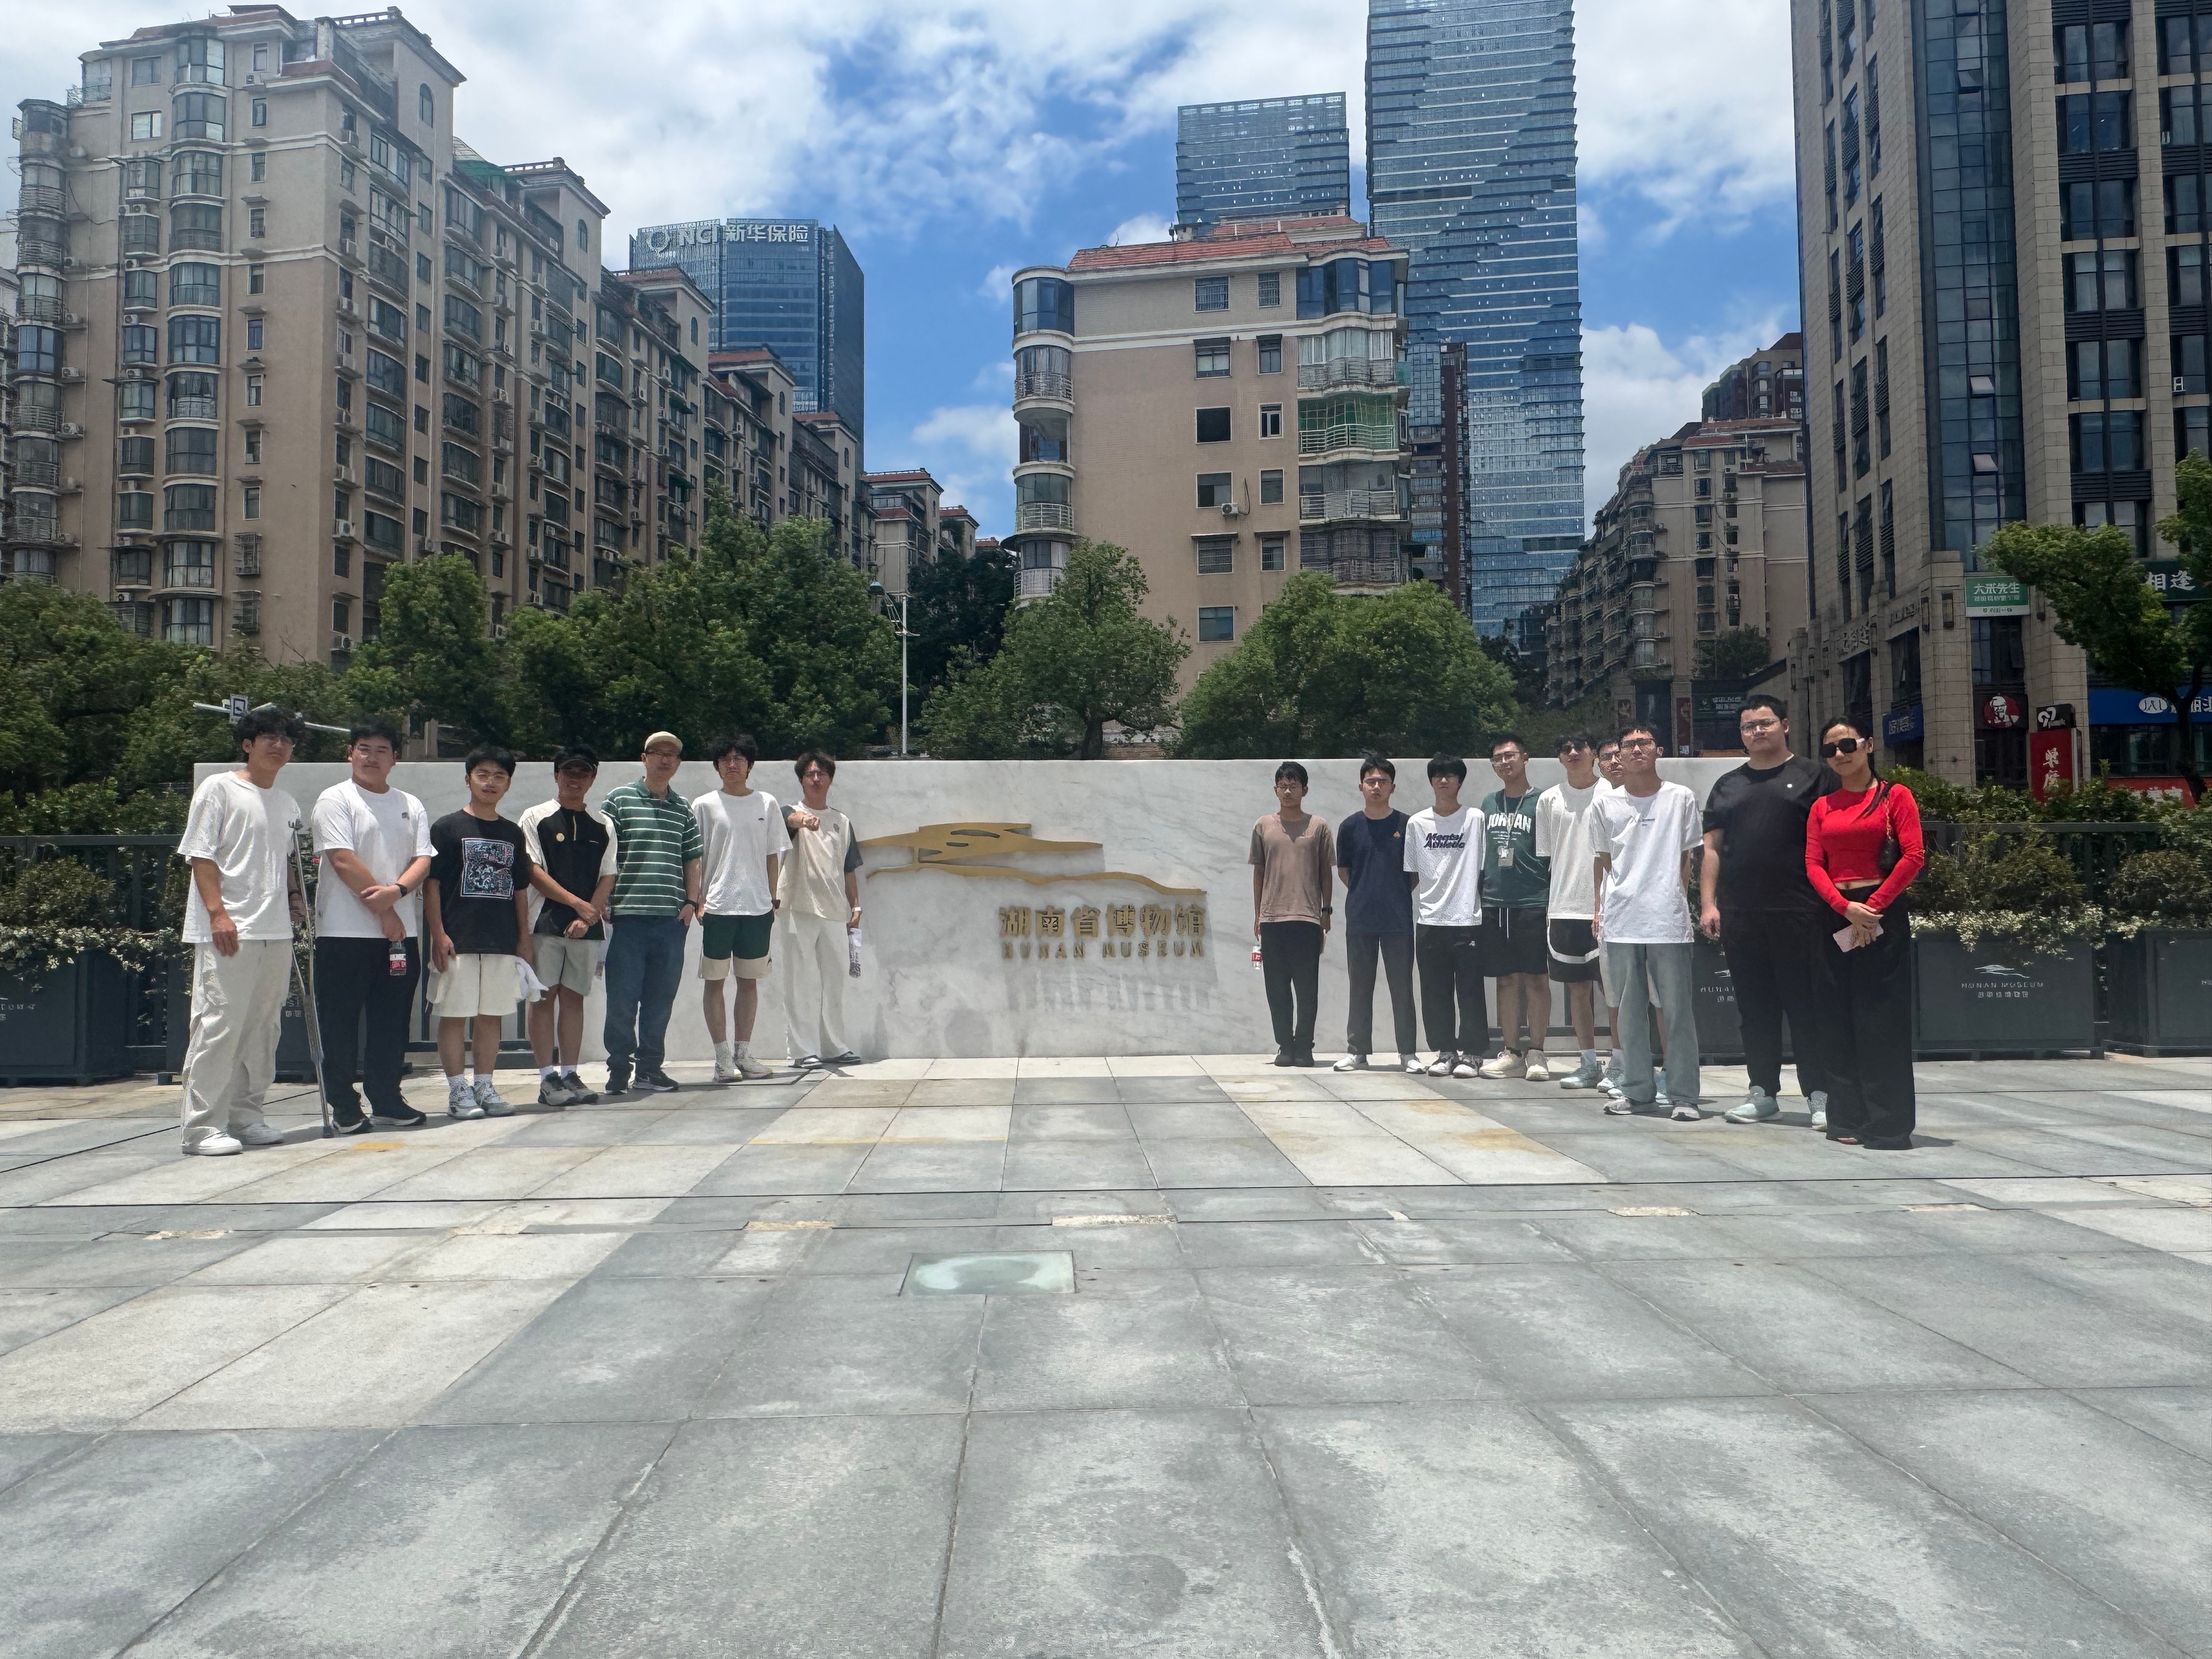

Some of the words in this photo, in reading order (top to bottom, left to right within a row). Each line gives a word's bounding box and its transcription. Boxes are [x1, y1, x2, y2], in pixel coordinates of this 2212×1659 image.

[726, 224, 809, 242] 新华保险
[1974, 582, 2020, 594] 大米先生
[999, 904, 1205, 938] 湖南省博物馆
[1002, 941, 1085, 959] HUNAN
[1103, 940, 1204, 958] MUSEUM
